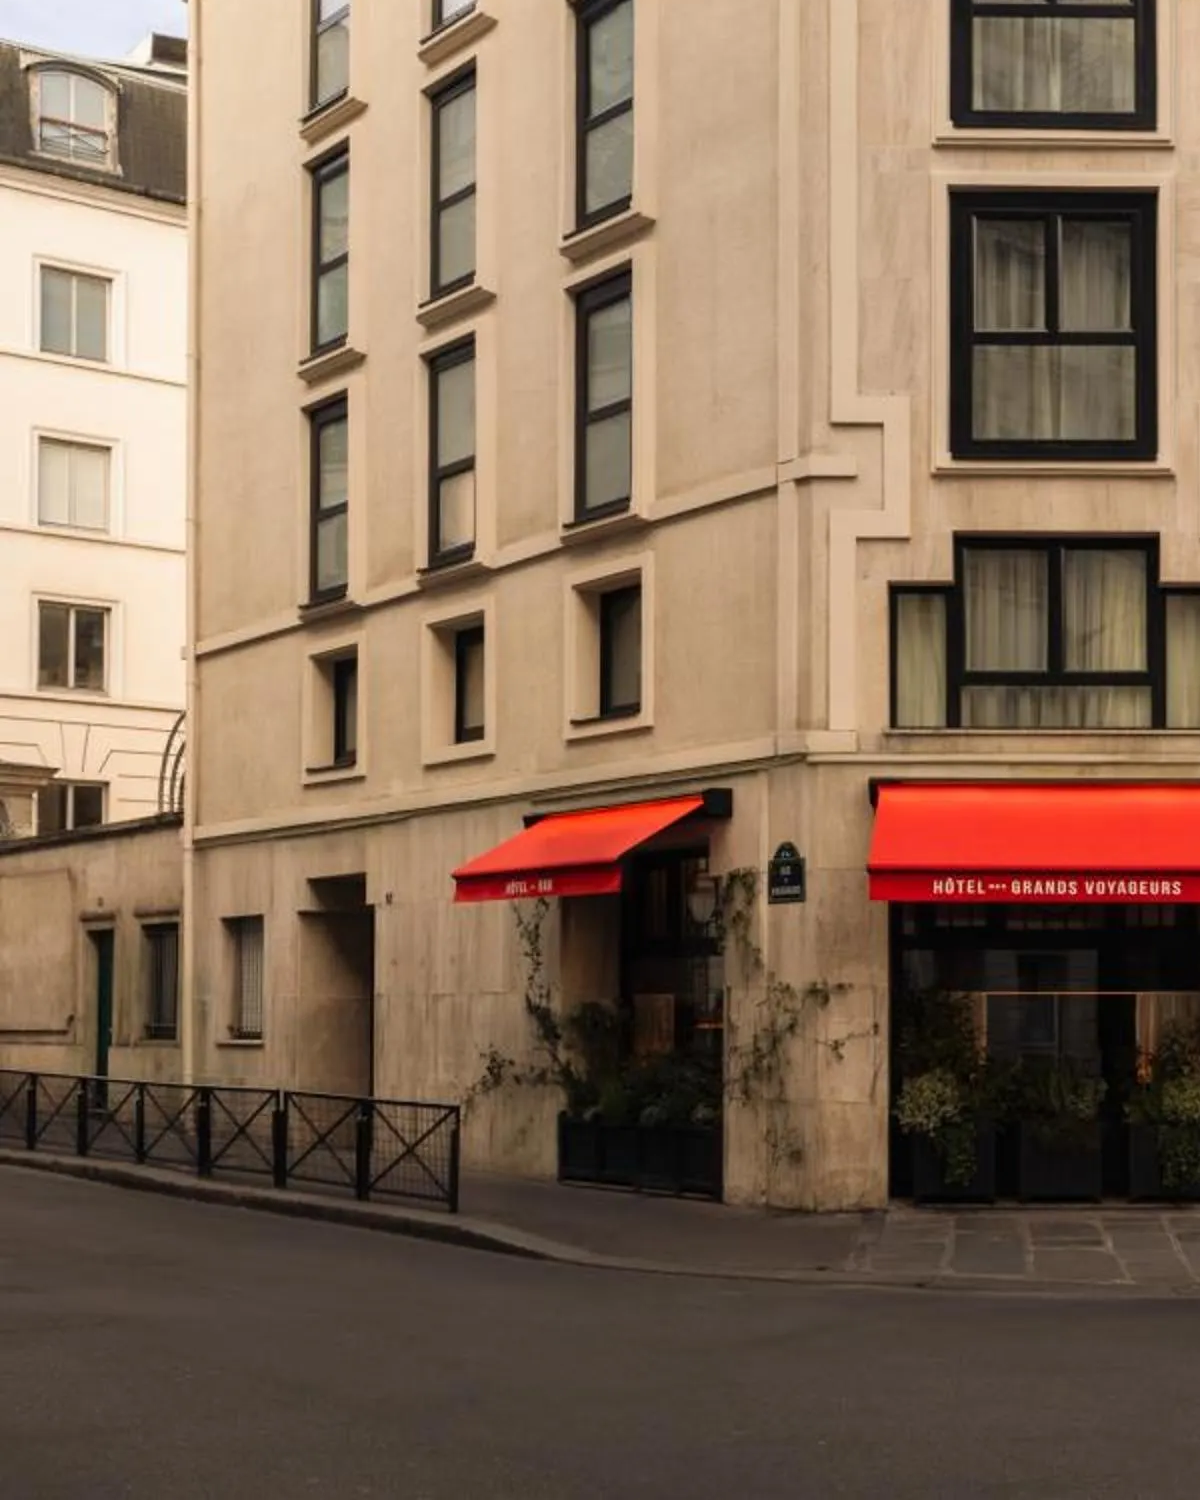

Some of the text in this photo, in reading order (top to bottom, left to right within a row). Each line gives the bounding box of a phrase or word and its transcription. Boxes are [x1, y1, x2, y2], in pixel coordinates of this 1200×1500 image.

[932, 878, 986, 895] HÔTEL
[1011, 880, 1078, 896] GRANDS
[1085, 880, 1182, 896] VOYAGEURS
